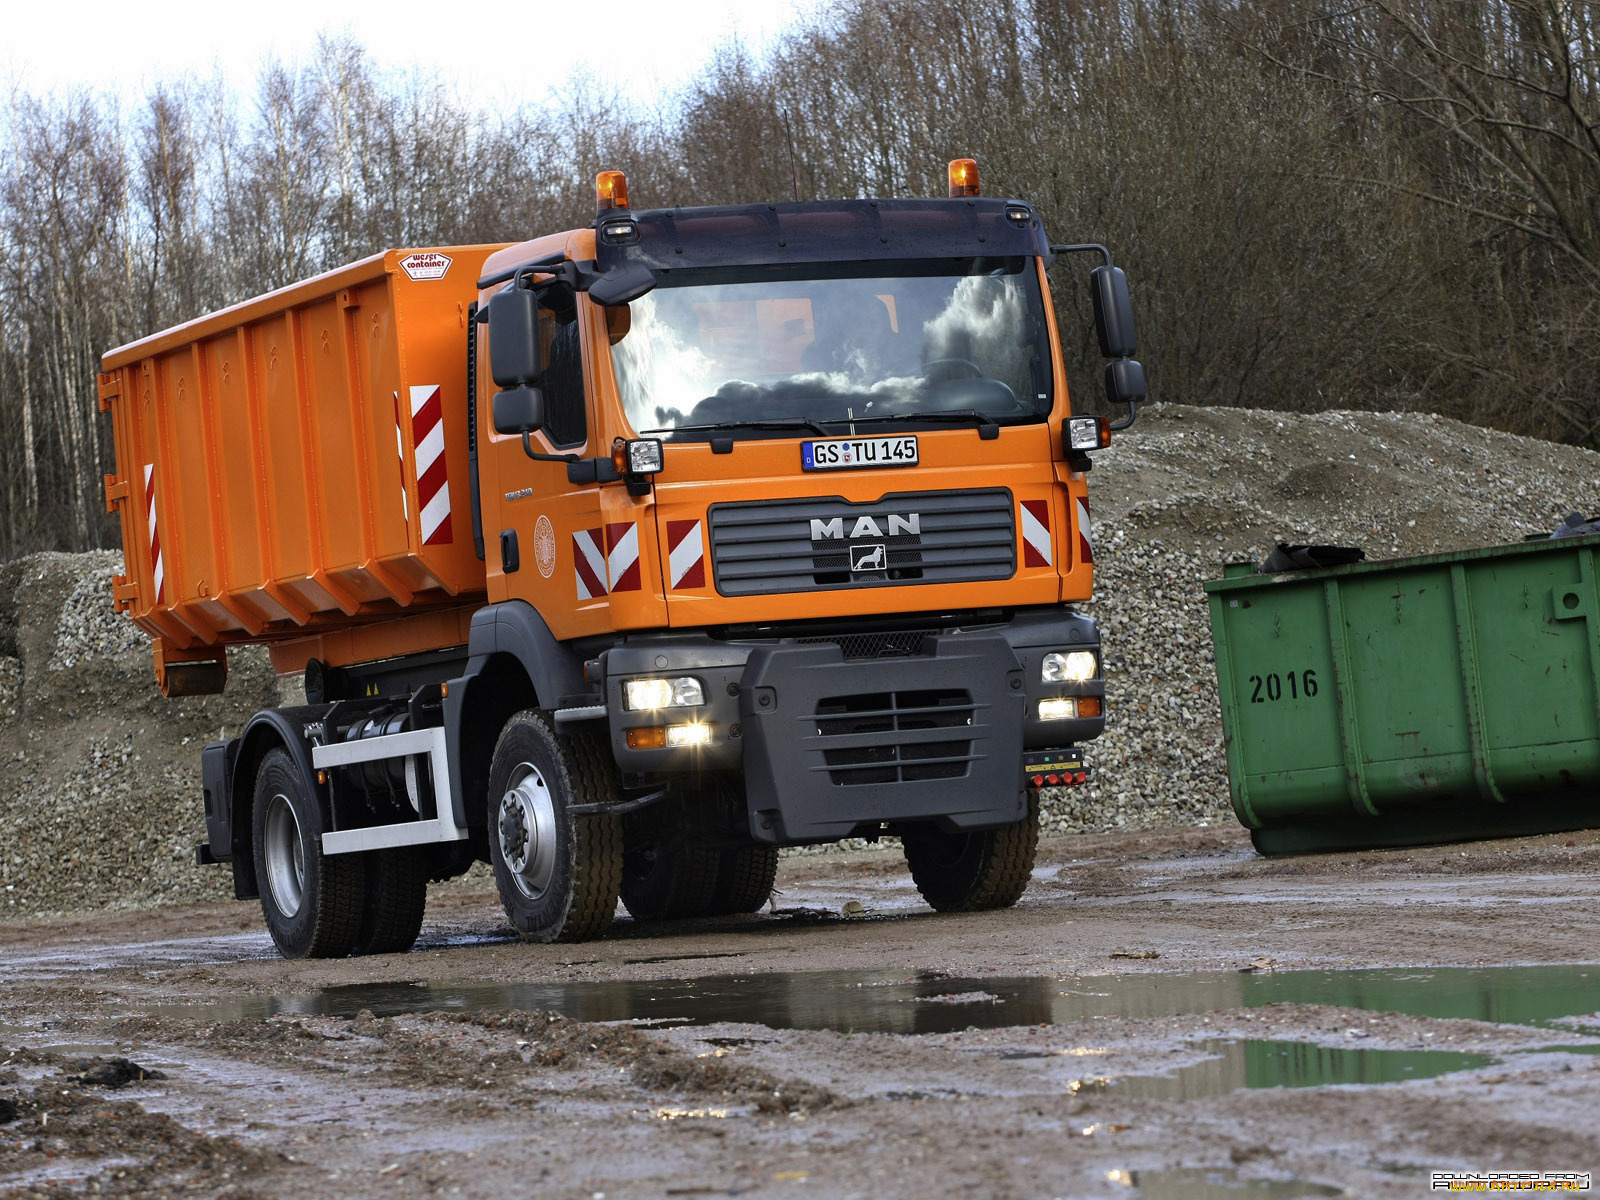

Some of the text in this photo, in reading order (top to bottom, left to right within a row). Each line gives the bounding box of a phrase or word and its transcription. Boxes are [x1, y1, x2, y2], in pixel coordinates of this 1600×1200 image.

[407, 260, 445, 268] container
[814, 444, 839, 464] GS
[852, 442, 877, 461] TU
[881, 440, 916, 460] 145
[810, 513, 921, 541] MAN
[1249, 669, 1318, 704] 2016
